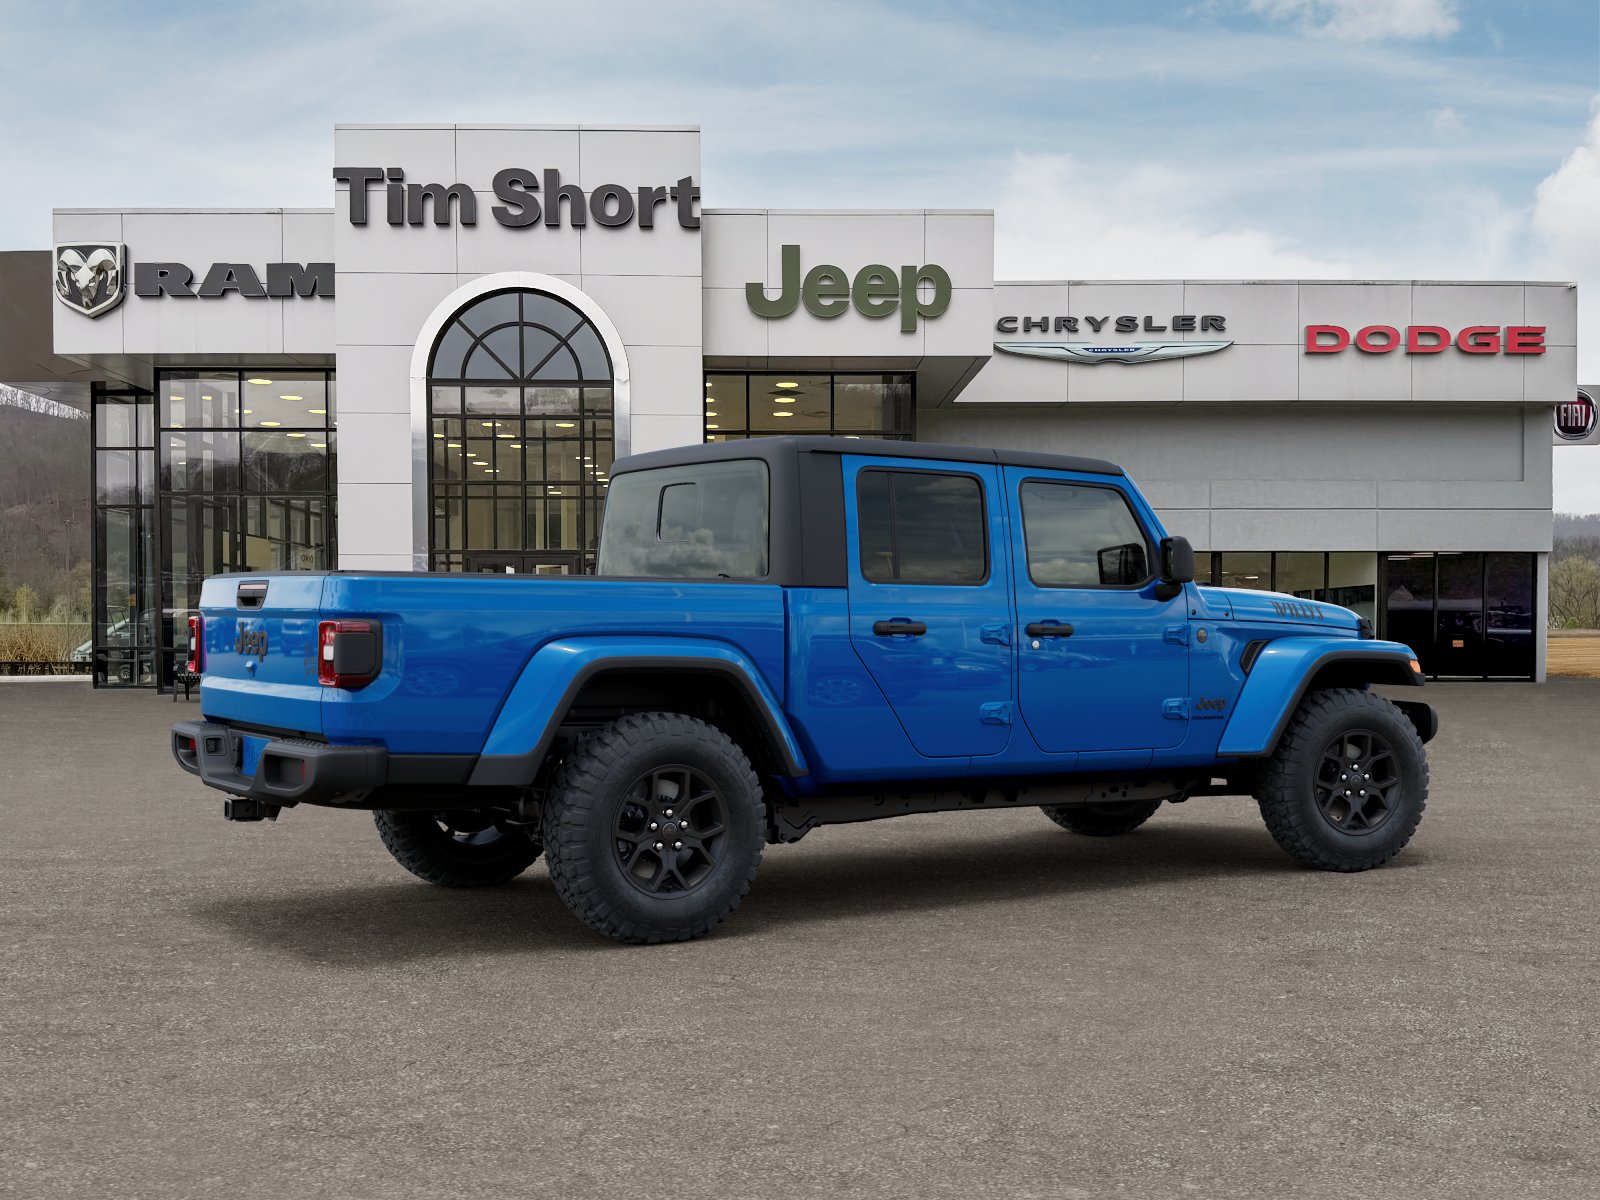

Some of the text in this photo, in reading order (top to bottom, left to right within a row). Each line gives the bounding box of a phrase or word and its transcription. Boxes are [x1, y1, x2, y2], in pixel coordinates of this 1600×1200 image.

[333, 167, 700, 229] Tim Short
[134, 263, 335, 299] RAM
[745, 244, 953, 333] Jeep
[996, 315, 1227, 333] CHRYSLER
[1304, 325, 1547, 355] DODGE
[1560, 404, 1586, 427] FIAT
[1270, 600, 1324, 620] WILLYS
[235, 621, 268, 663] Jeep
[1196, 695, 1226, 712] Jeep
